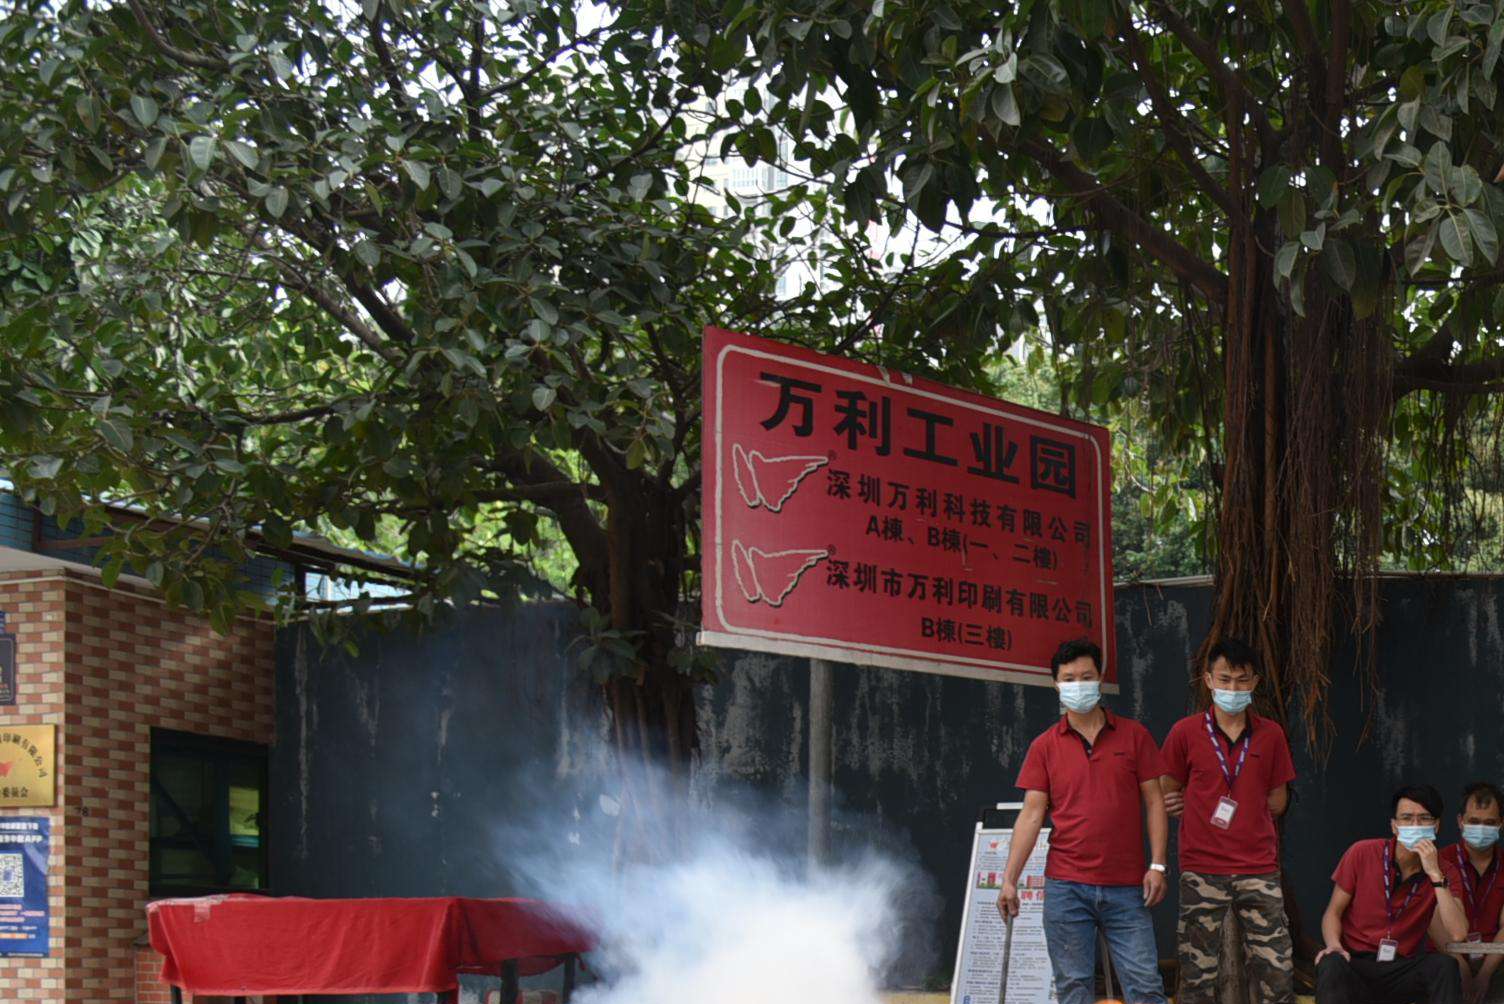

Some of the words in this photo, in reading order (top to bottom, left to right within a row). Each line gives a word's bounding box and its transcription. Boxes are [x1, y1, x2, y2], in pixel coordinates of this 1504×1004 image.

[760, 371, 1077, 499] 万利工业园
[826, 467, 1092, 550] 深圳万利科技有限公司
[825, 558, 1094, 630] 深圳市万利印刷有限公司
[0, 732, 49, 778] 印刷有限公司
